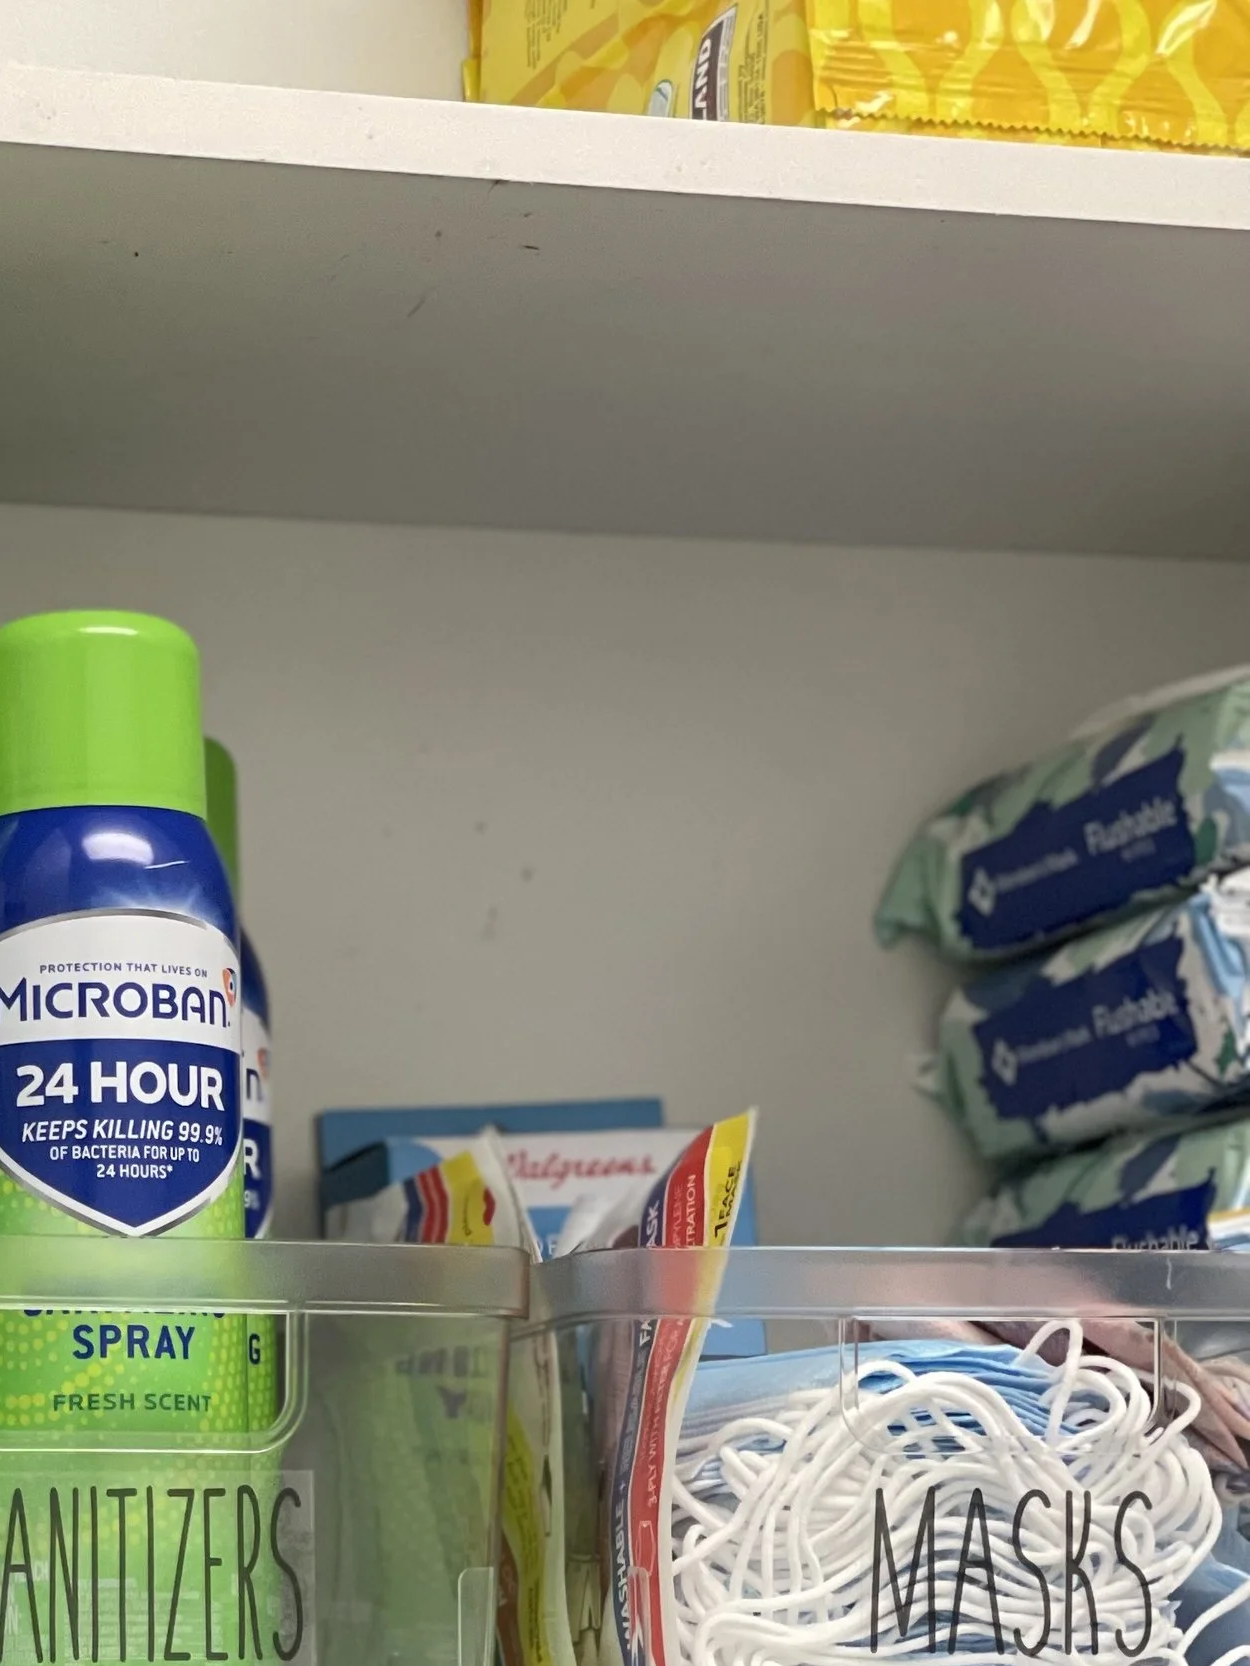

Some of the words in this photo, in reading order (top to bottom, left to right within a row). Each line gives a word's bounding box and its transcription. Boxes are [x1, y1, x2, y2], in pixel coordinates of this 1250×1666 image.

[40, 963, 122, 974] PROTECTION
[127, 963, 157, 973] THAT
[161, 965, 191, 976] LIVES
[194, 968, 208, 978] ON
[16, 1062, 78, 1107] 24
[90, 1061, 225, 1111] HOUR
[22, 1120, 87, 1143] KEEPS
[93, 1119, 173, 1140] KILLING
[178, 1122, 223, 1146] 99.9%
[50, 1146, 67, 1161] OF
[72, 1145, 140, 1160] BACTERIA
[144, 1146, 168, 1160] FOR
[169, 1147, 185, 1161] UP
[187, 1149, 200, 1162] TO
[96, 1164, 115, 1178] 24
[718, 1166, 737, 1220] FACE
[72, 1325, 195, 1360] SPRAY
[53, 1394, 133, 1412] FRESH
[143, 1394, 211, 1413] SCENT
[871, 1486, 1153, 1658] MASKS
